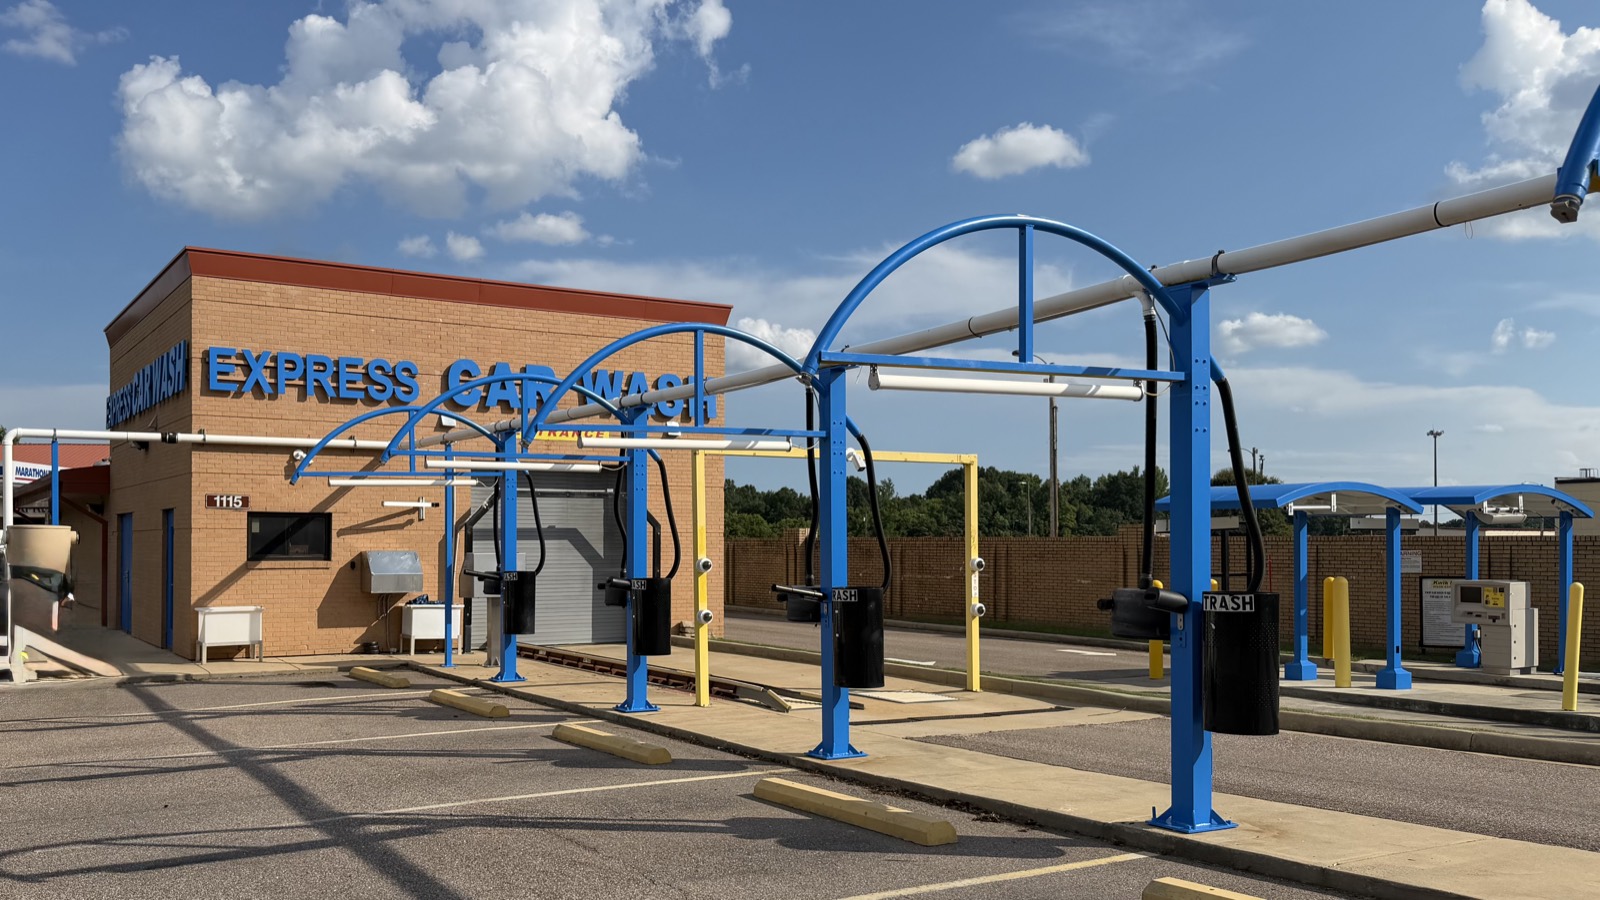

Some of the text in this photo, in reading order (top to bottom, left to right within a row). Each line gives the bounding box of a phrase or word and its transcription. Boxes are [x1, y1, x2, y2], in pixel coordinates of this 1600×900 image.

[106, 339, 186, 430] EXPRESS CAR WASH
[208, 346, 717, 419] EXPRESS CAR WASH
[214, 495, 243, 508] 1115
[832, 590, 857, 601] RASH
[1204, 595, 1254, 610] TRASH
